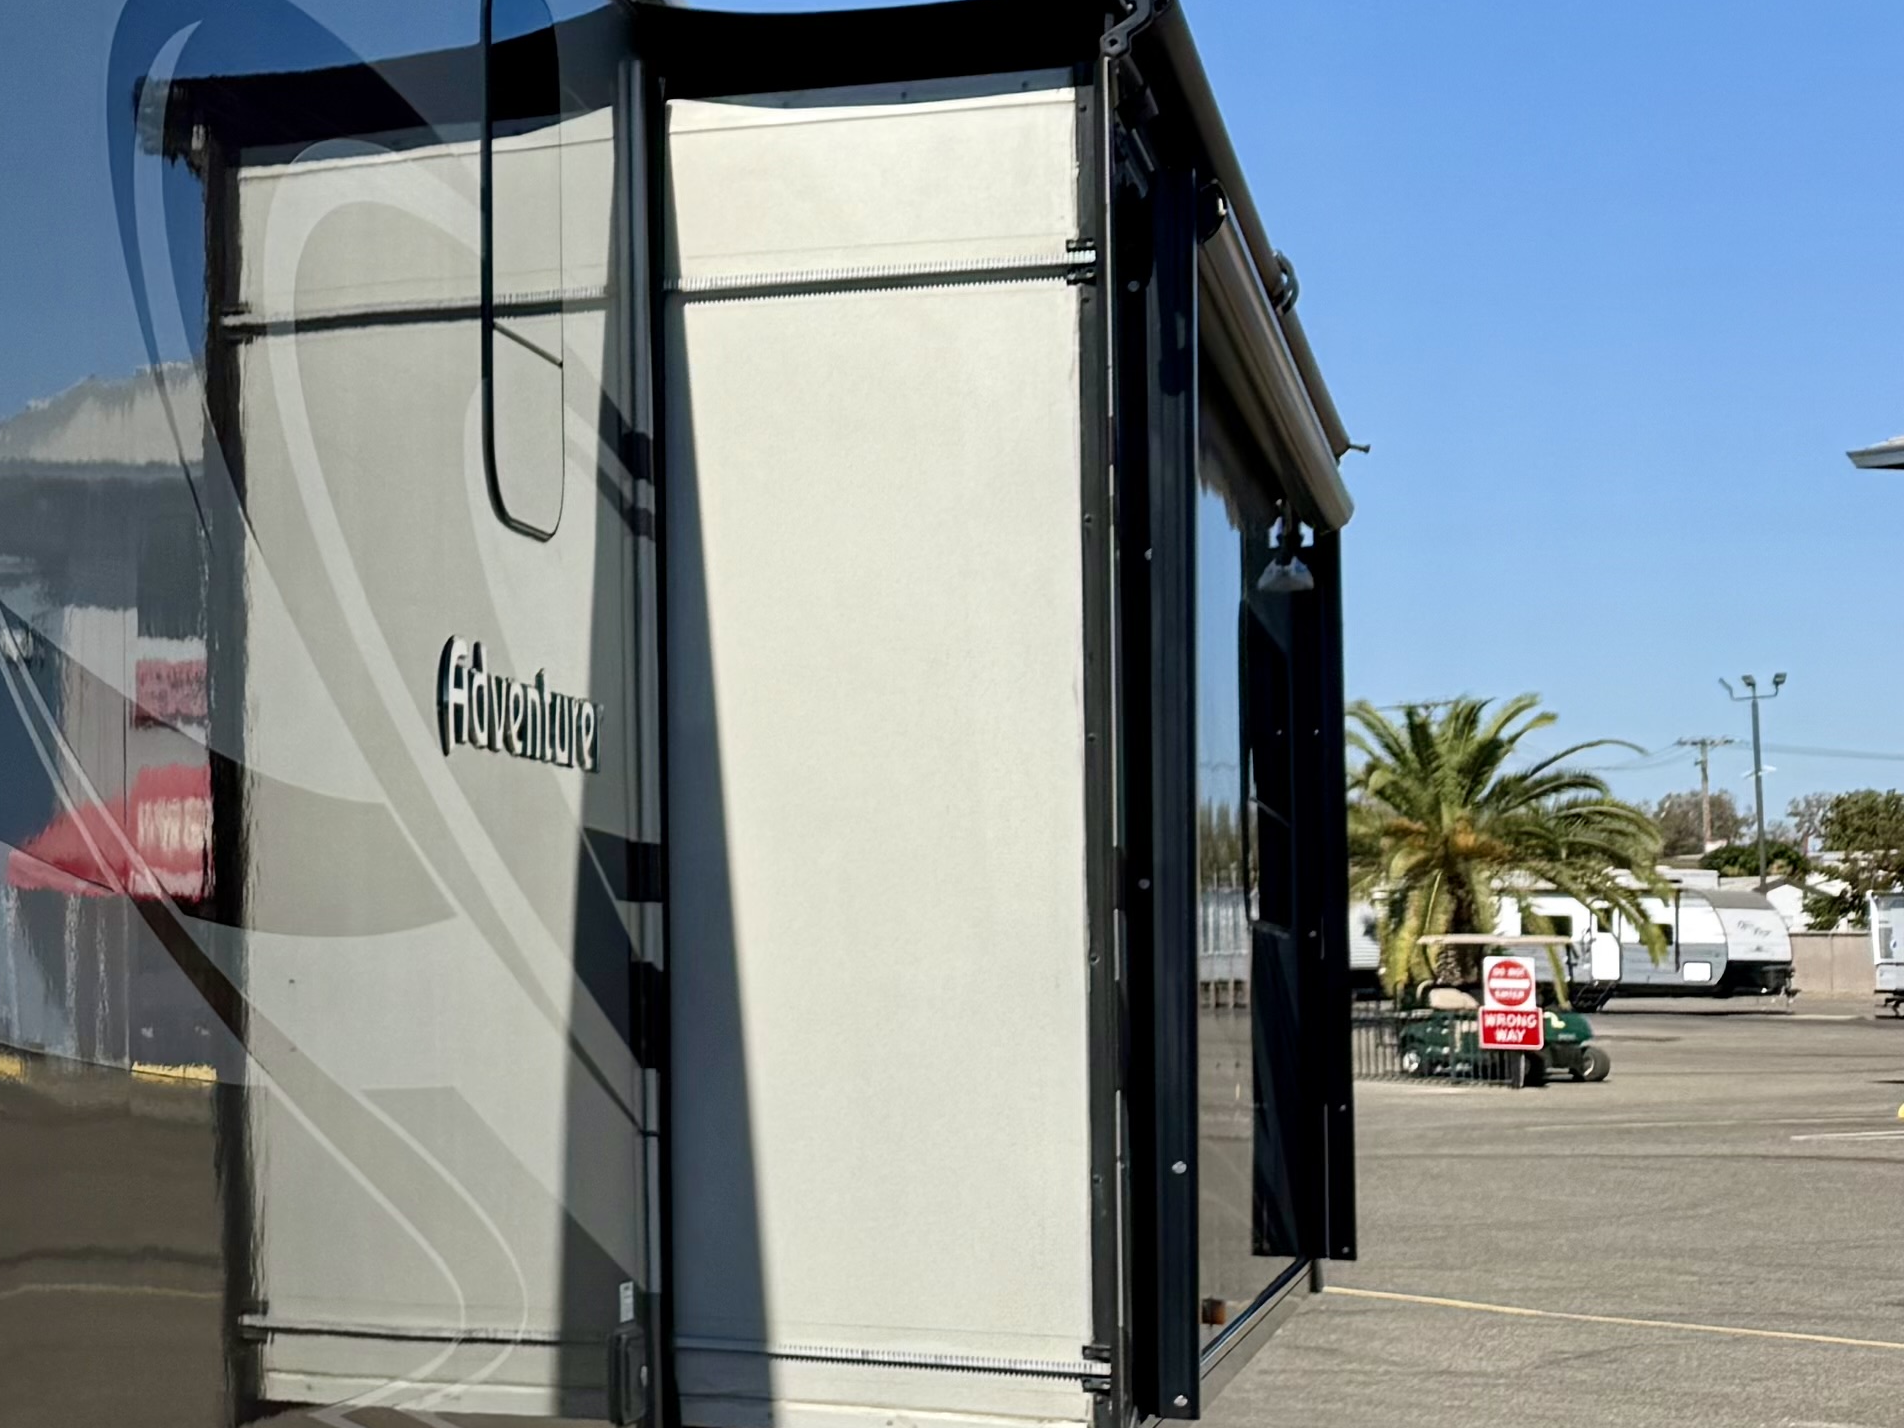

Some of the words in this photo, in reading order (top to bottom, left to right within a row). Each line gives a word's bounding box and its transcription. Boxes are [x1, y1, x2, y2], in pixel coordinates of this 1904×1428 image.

[436, 634, 604, 774] Adventurer
[1484, 1013, 1537, 1028] WRONG
[1495, 1029, 1526, 1043] WAY
